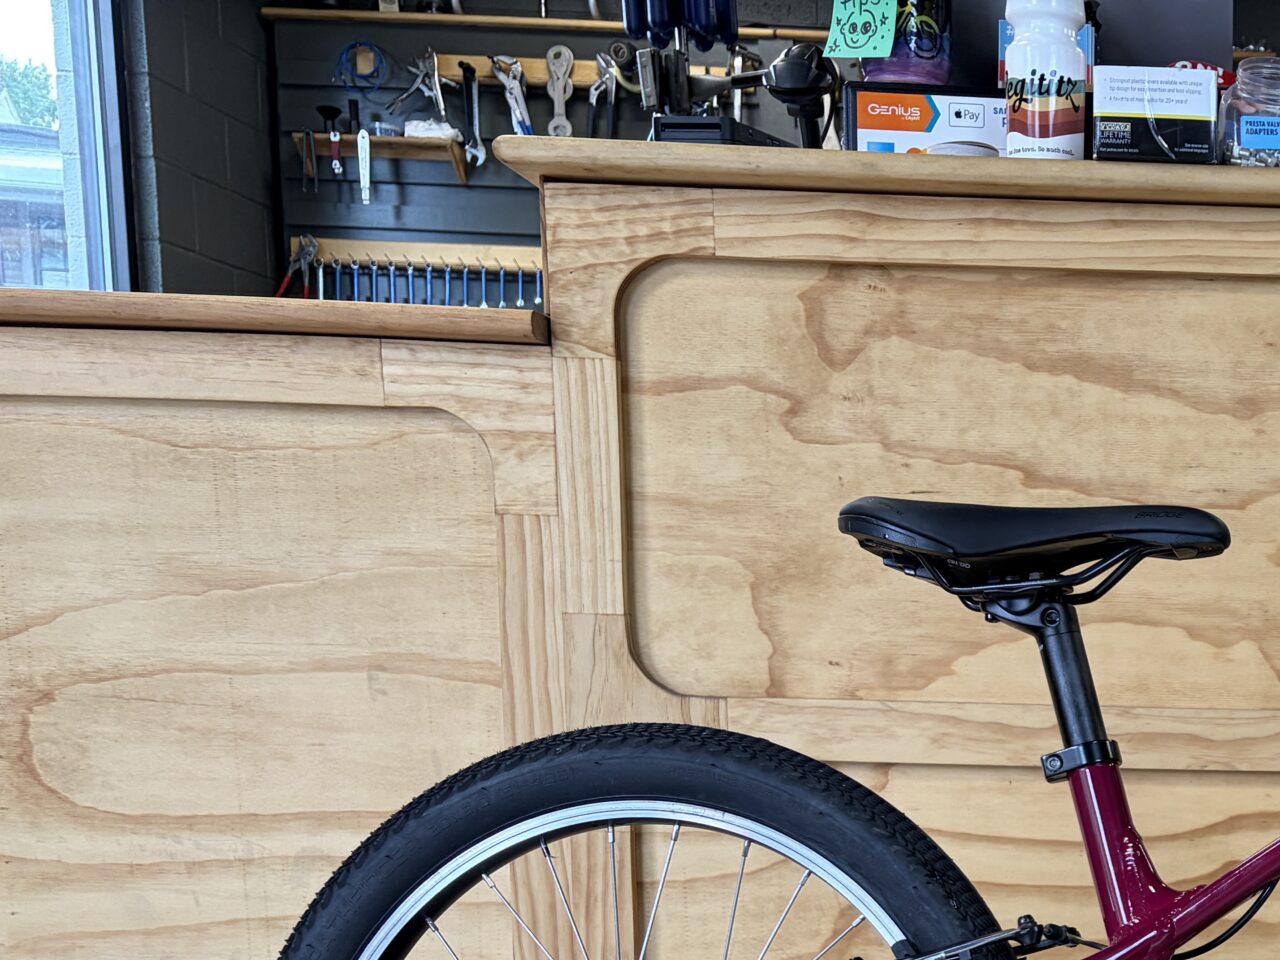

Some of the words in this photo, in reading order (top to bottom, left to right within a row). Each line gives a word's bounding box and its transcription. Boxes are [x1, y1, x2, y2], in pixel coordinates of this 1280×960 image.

[963, 109, 980, 122] Pay
[1245, 120, 1265, 128] PRESTA
[1100, 131, 1132, 139] LIFETIME
[1245, 127, 1278, 136] ADAPTERS
